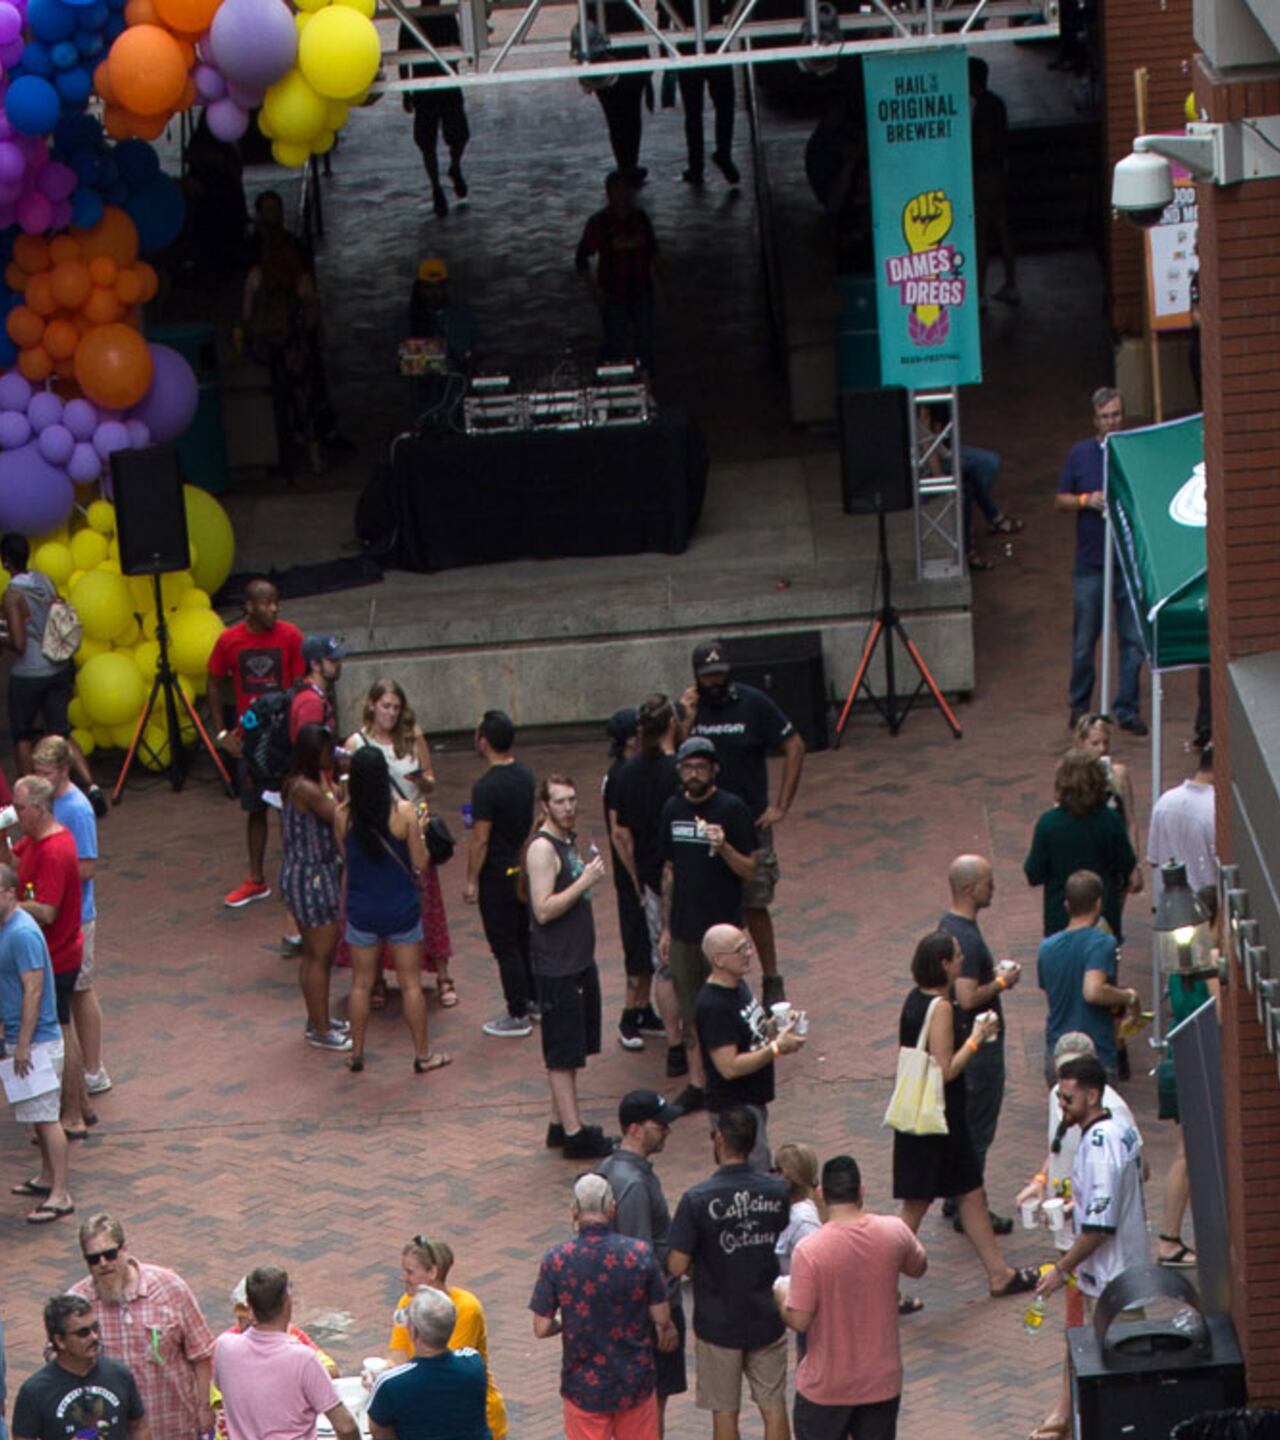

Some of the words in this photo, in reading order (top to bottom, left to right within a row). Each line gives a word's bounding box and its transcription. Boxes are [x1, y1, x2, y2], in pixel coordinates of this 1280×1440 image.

[894, 75, 929, 97] HAIL
[878, 93, 957, 122] ORIGINAL
[886, 119, 952, 144] BREWER!
[889, 248, 952, 283] DAMES
[904, 280, 962, 305] DREGS
[1091, 1127, 1105, 1147] 5
[708, 1191, 782, 1221] Caffeine
